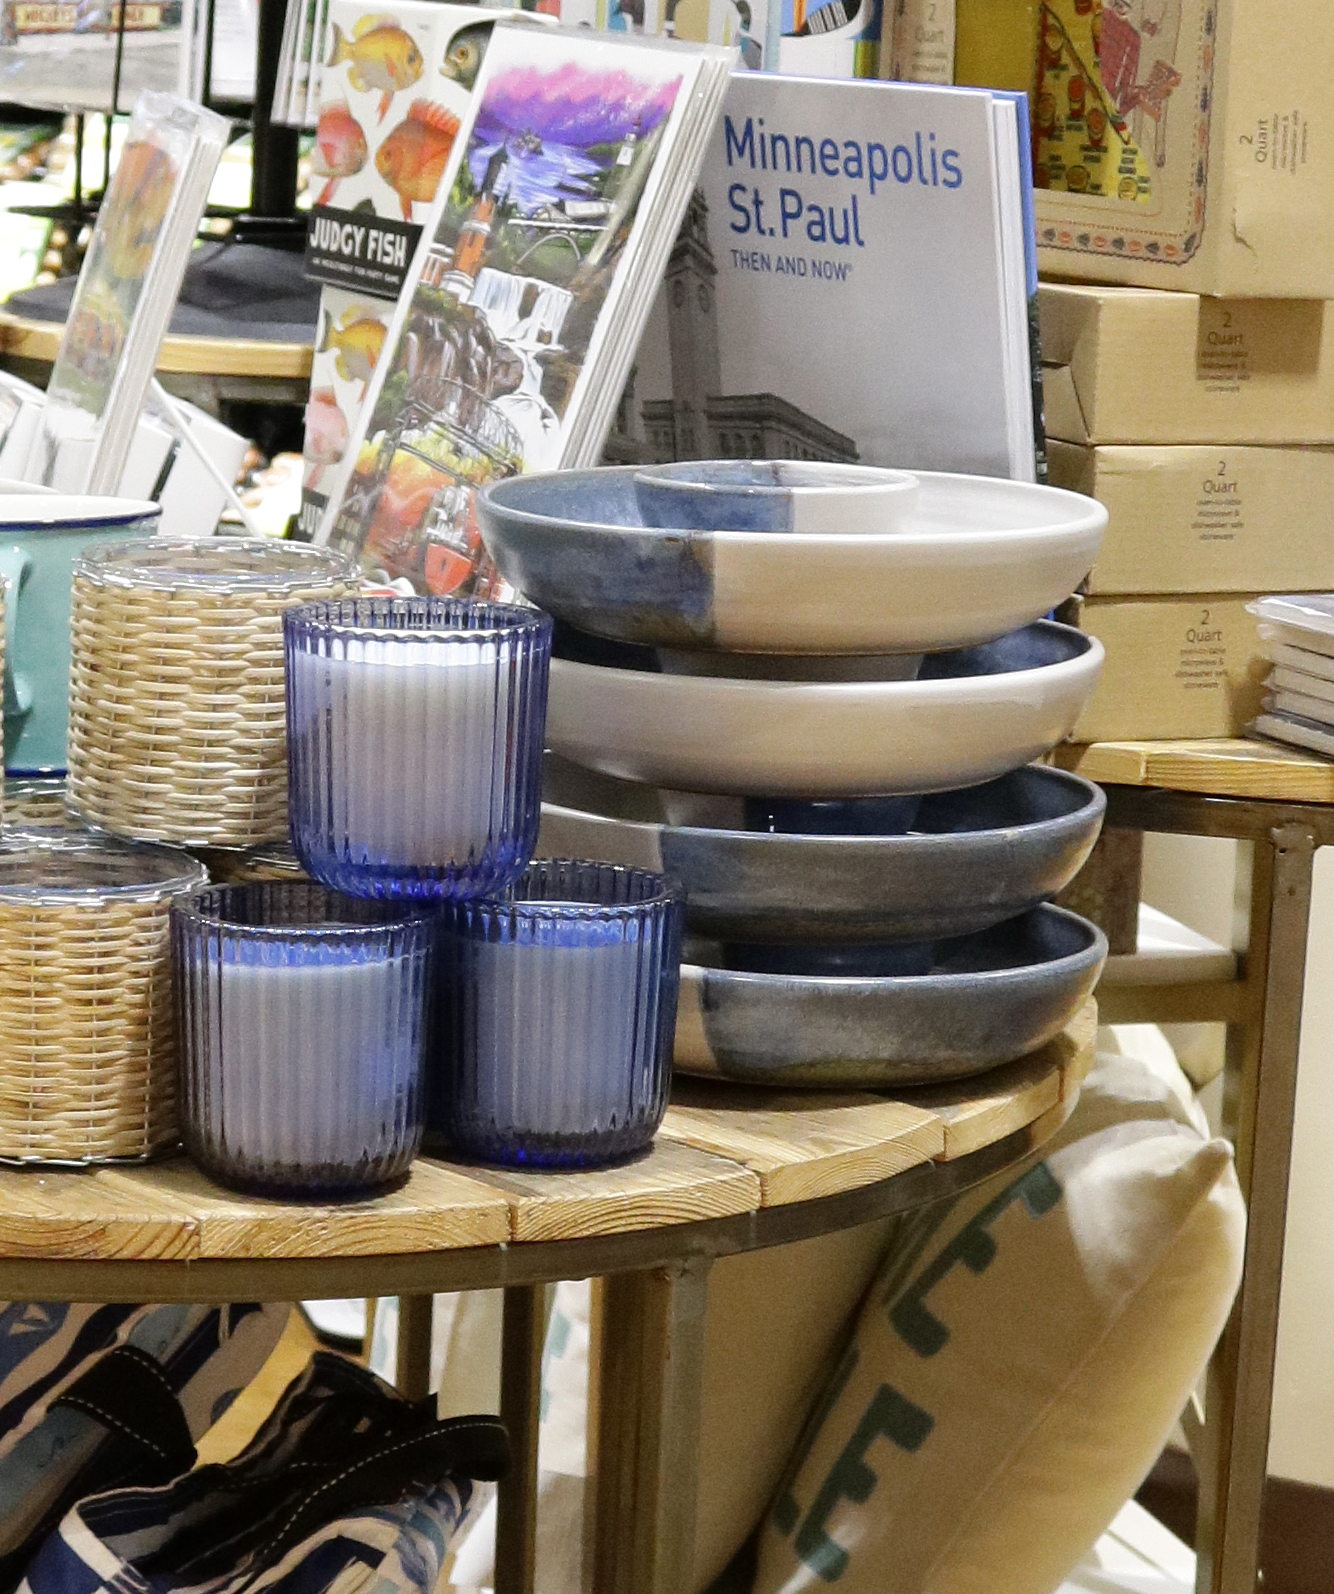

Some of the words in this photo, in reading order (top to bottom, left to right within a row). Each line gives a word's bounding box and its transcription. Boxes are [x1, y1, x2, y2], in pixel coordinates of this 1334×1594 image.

[724, 115, 963, 195] Minneapolis
[310, 216, 365, 257] JUDGY
[367, 229, 406, 267] FISH
[730, 249, 771, 272] THEN
[775, 256, 807, 276] AND
